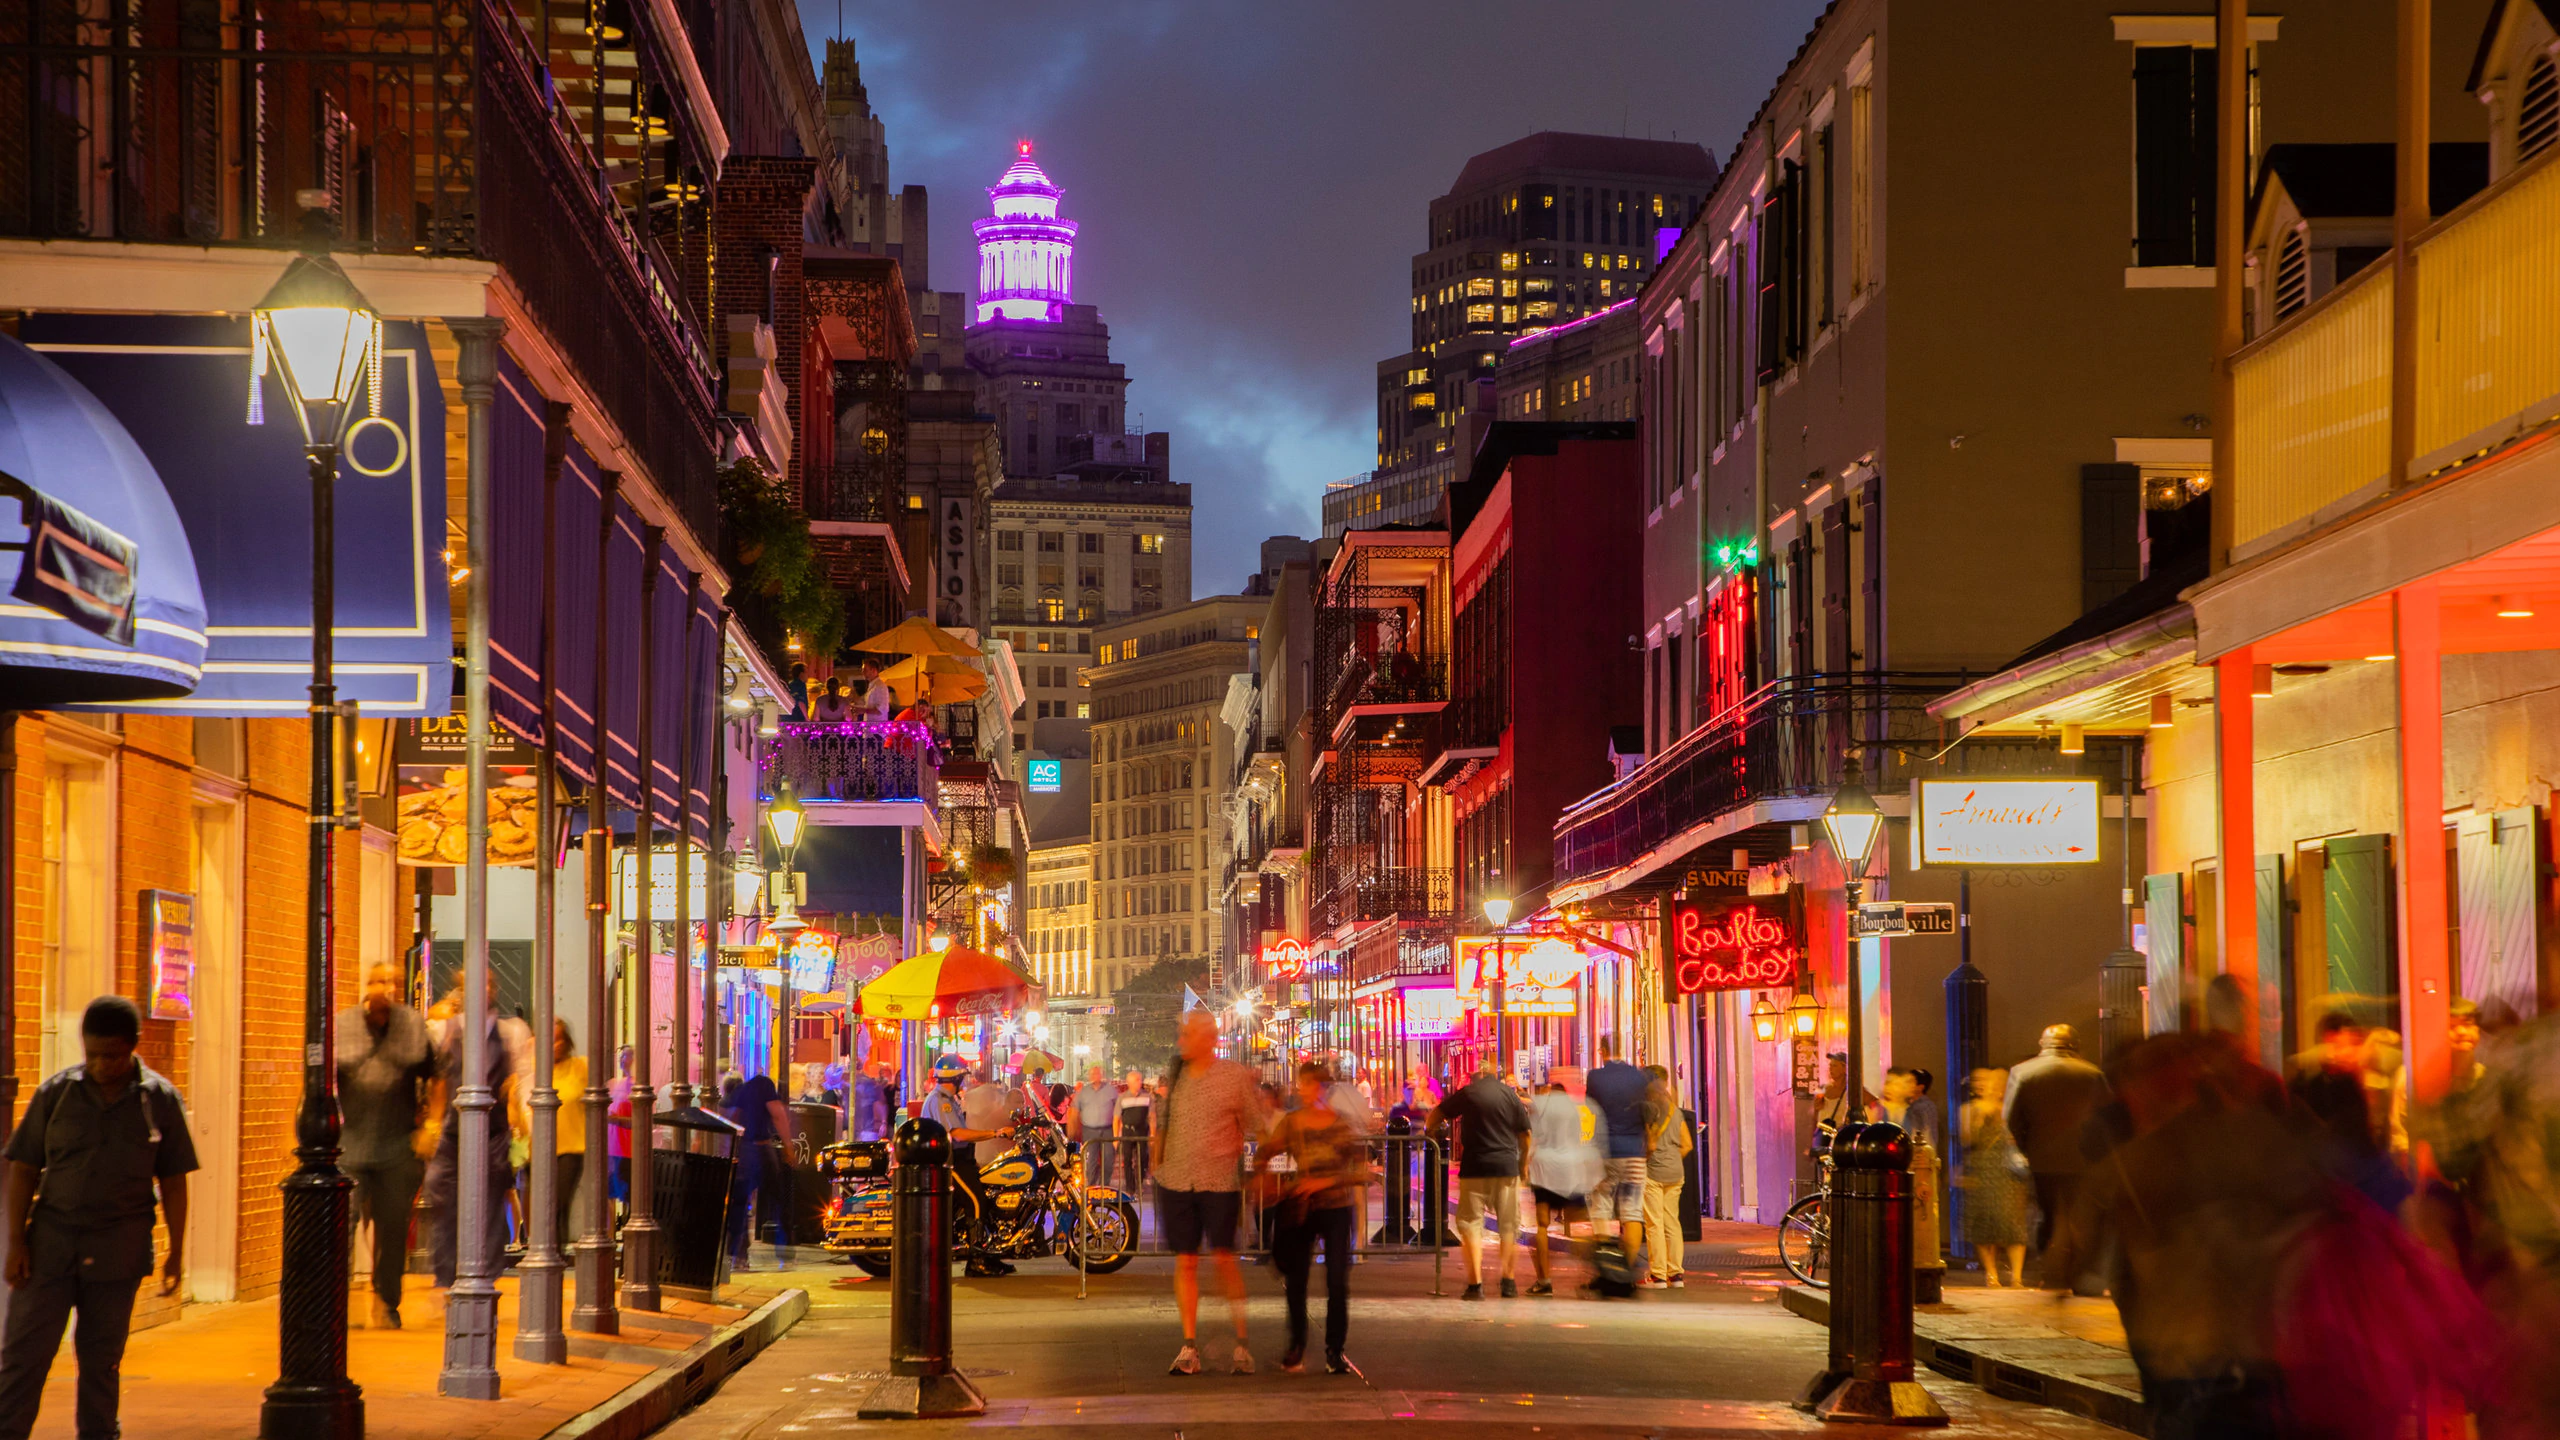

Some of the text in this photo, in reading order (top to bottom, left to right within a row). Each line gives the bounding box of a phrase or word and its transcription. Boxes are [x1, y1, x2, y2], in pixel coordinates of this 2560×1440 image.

[1033, 764, 1056, 777] AC
[1686, 870, 1749, 887] SAINTS
[1860, 913, 1904, 930] Bourbon
[1905, 914, 1951, 930] ville
[717, 952, 776, 966] Bienville
[1262, 946, 1310, 963] Hard Rock
[872, 1209, 893, 1217] POLI
